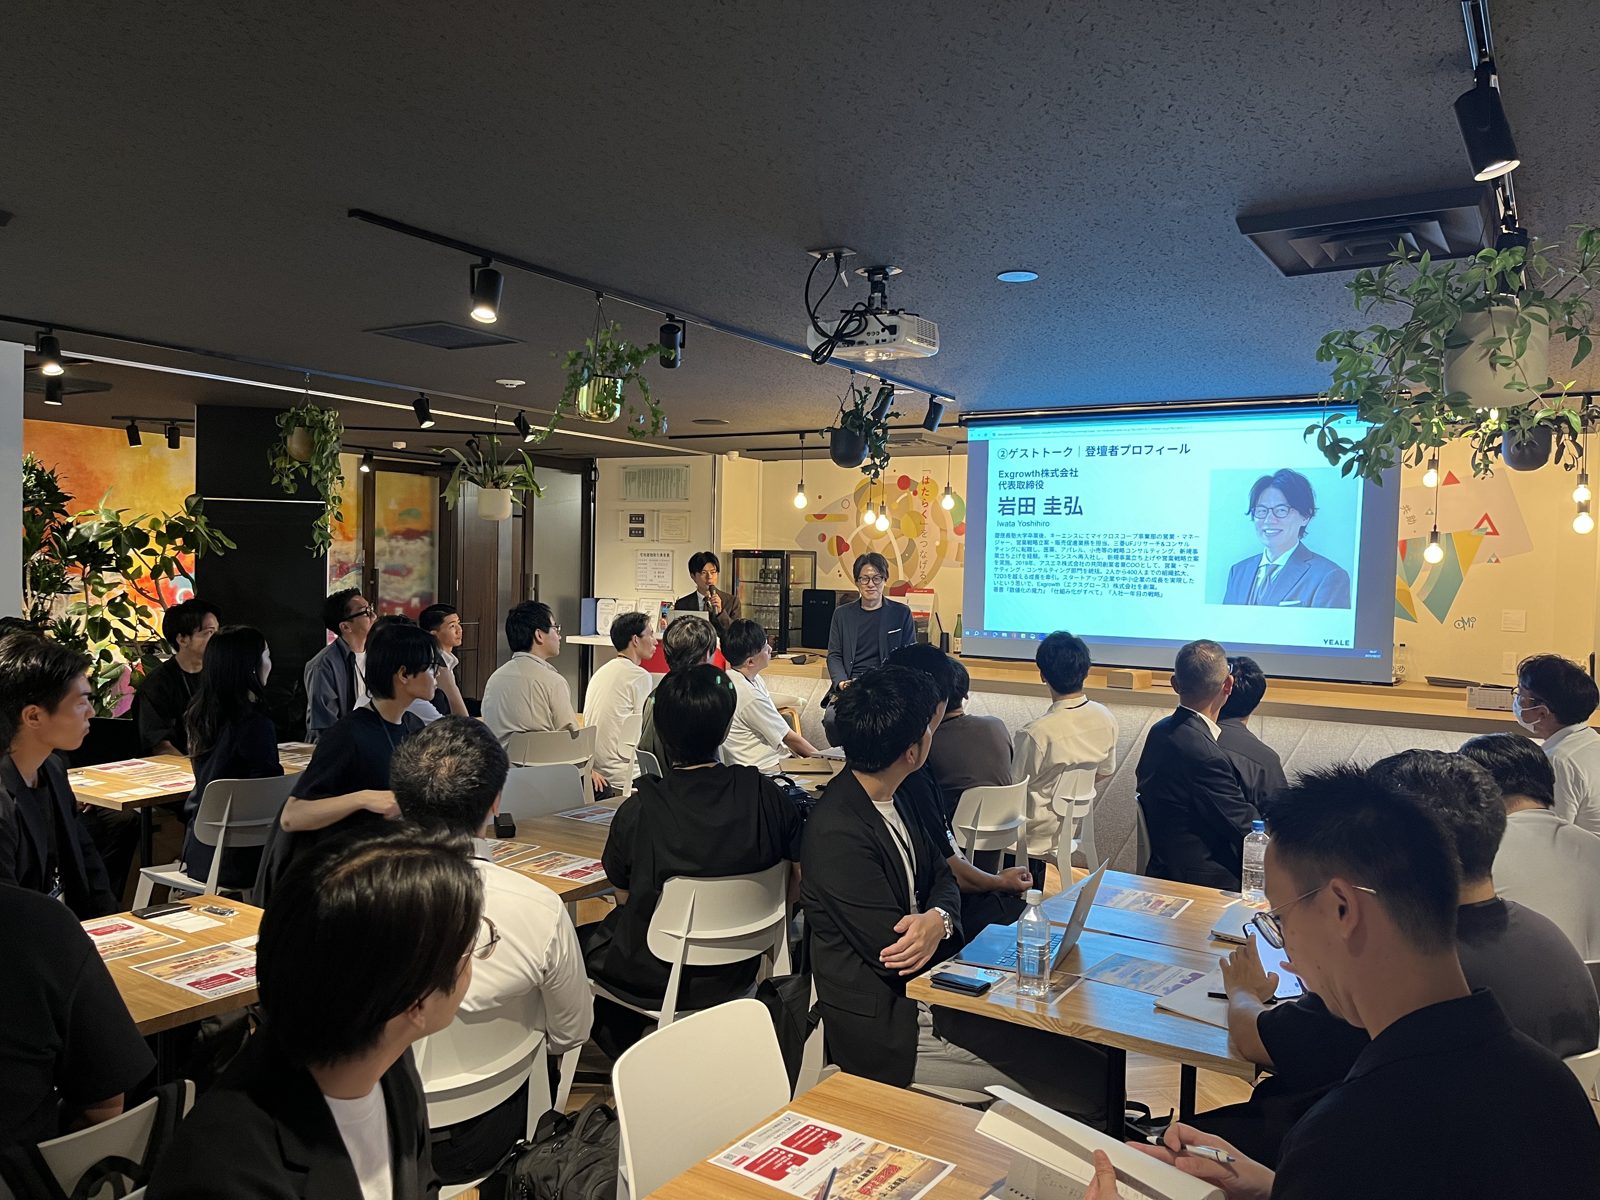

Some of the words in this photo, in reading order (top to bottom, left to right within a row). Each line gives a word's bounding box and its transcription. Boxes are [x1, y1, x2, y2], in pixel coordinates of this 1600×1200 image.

[998, 468, 1079, 479] Exgrowth株式会社
[998, 480, 1044, 490] 代表取締役
[997, 496, 1036, 516] 岩田
[1043, 496, 1083, 516] 圭弘
